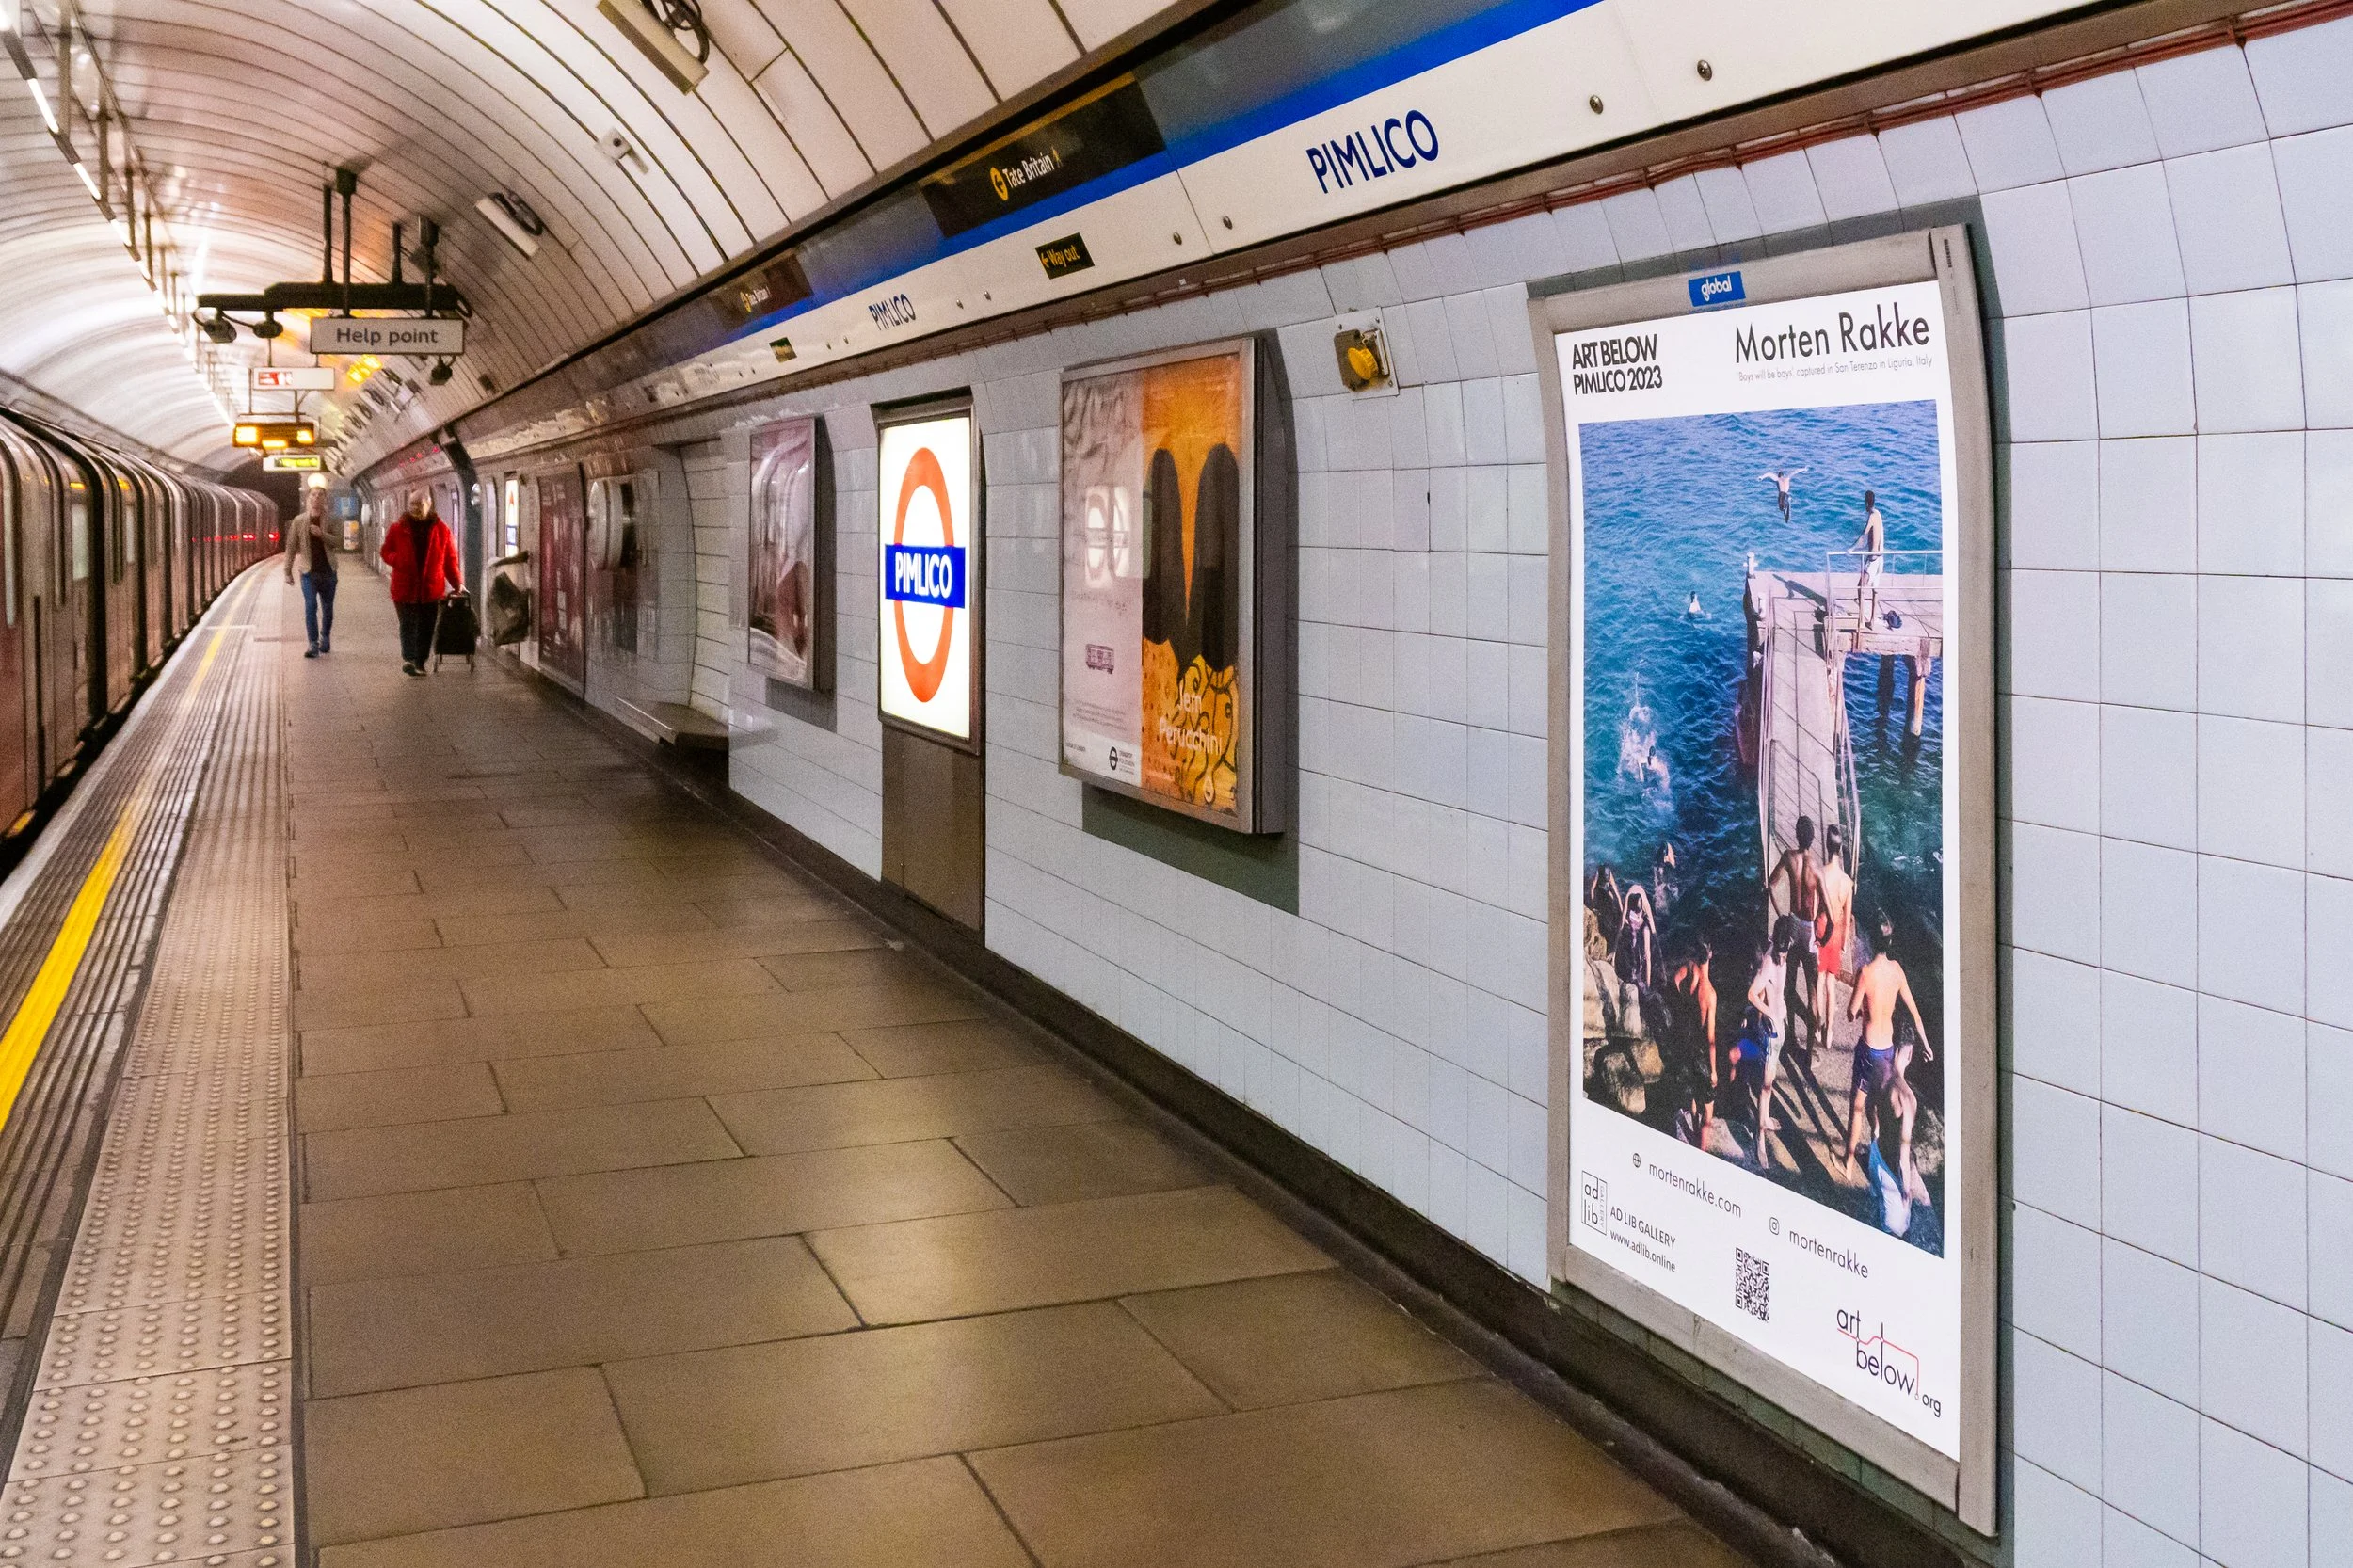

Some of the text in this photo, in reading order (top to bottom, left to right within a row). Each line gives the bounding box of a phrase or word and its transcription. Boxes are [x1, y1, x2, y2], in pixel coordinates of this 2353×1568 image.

[1002, 152, 1055, 188] Tate Britain
[1305, 109, 1439, 194] PIMLICO
[1046, 245, 1080, 267] Way out
[1701, 274, 1733, 302] global
[868, 293, 917, 330] PIMLICO
[336, 328, 438, 346] Help point
[1736, 301, 1929, 363] Morten Rakke
[1572, 333, 1657, 370] ART BELOW
[1767, 367, 1776, 379] be
[1796, 362, 1826, 378] captured
[1827, 364, 1833, 374] in
[1835, 361, 1849, 374] San
[1849, 360, 1878, 372] Terenzo
[1880, 360, 1886, 369] in
[1888, 355, 1915, 371] Liguria,
[1916, 353, 1932, 368] Italy
[1573, 365, 1663, 395] PIMLICO 2023
[894, 552, 952, 599] PIMLICO
[1160, 715, 1224, 756] Perucchini
[1584, 1179, 1598, 1200] ad
[1649, 1163, 1741, 1218] mortenrakke.com
[1584, 1199, 1598, 1224] lib
[1610, 1206, 1676, 1250] AD LIB GALLERY
[1610, 1230, 1675, 1272] www.adlib.online
[1789, 1230, 1868, 1279] mortenrakke
[1836, 1309, 1861, 1338] art
